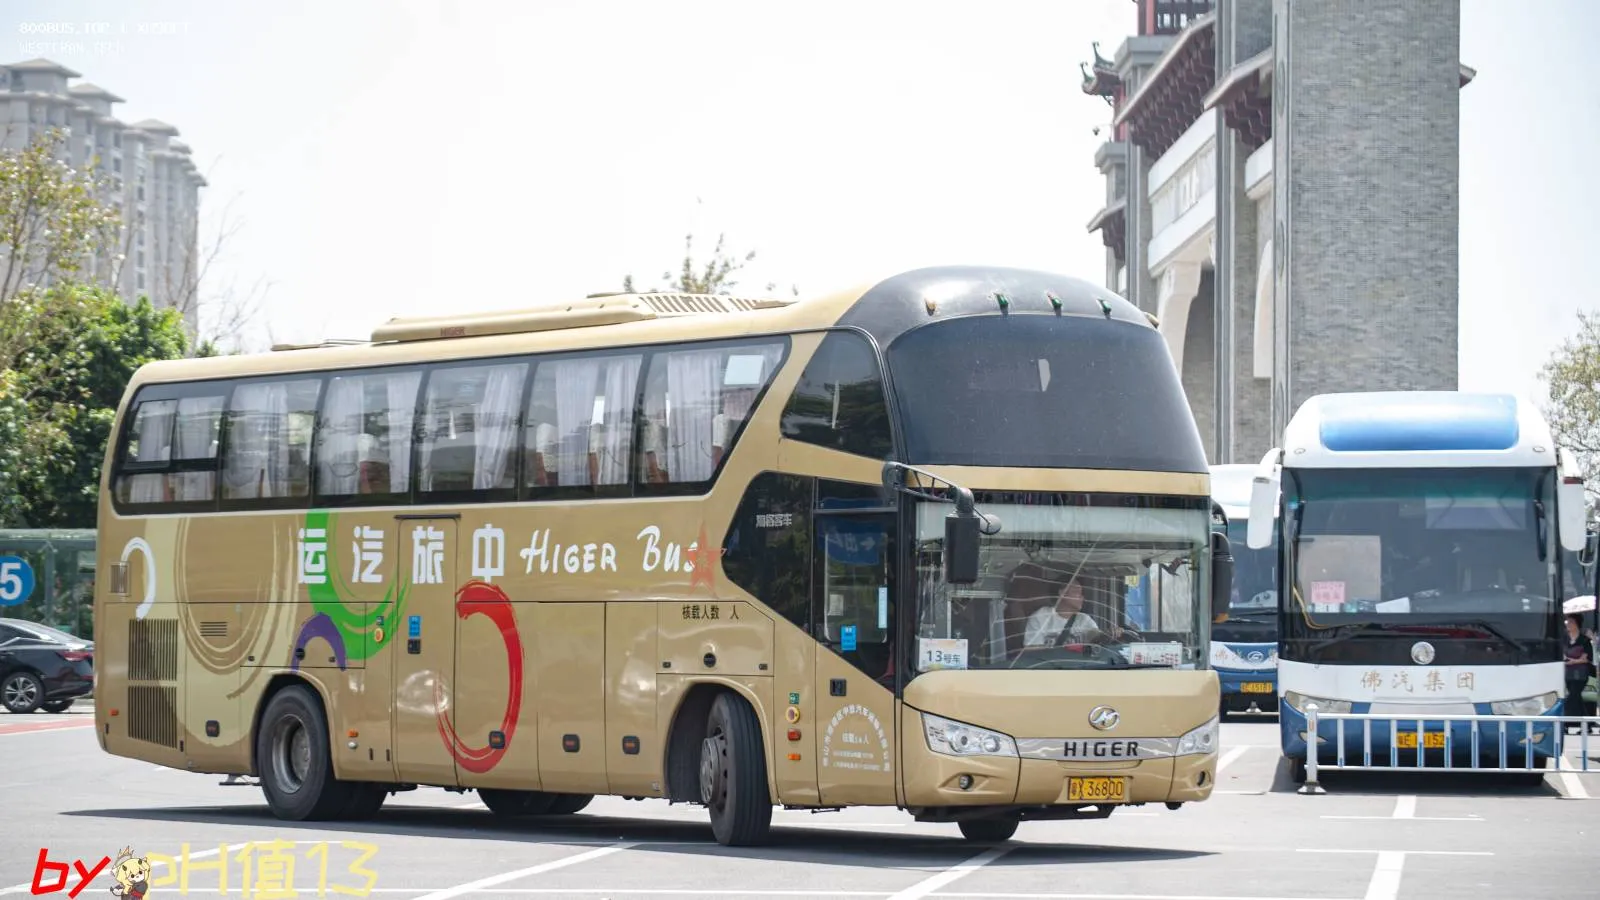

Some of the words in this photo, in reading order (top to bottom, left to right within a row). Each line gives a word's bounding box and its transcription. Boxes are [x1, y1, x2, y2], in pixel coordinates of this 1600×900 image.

[682, 604, 719, 620] 核载人数
[730, 604, 739, 620] 人
[1360, 670, 1475, 693] 佛汽集团
[1063, 741, 1138, 757] HIGER
